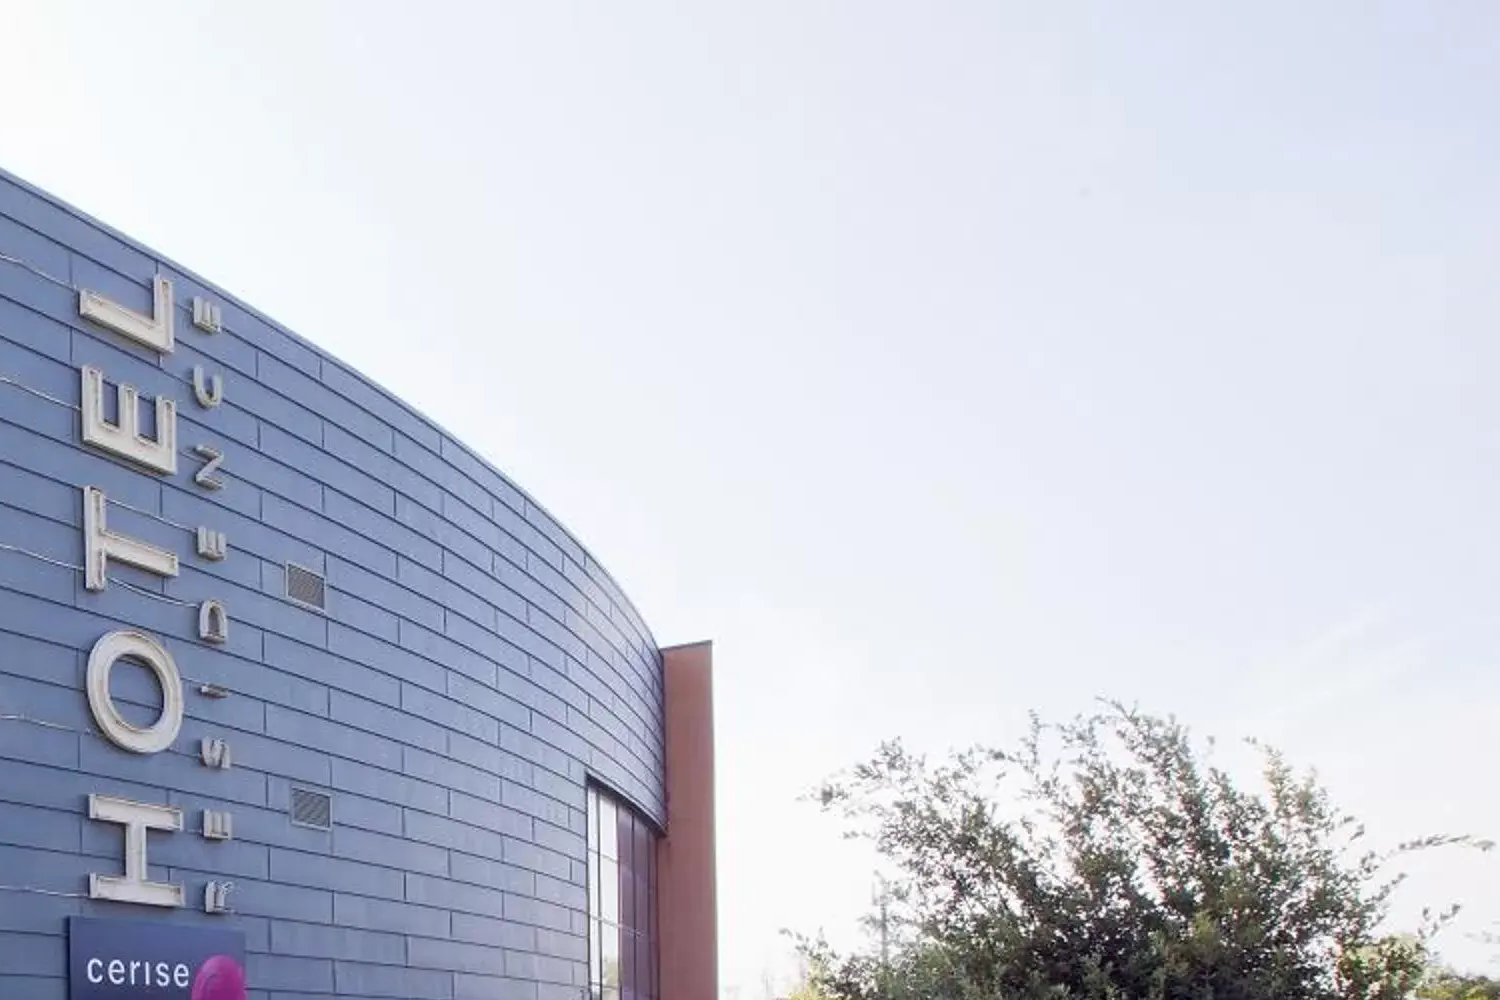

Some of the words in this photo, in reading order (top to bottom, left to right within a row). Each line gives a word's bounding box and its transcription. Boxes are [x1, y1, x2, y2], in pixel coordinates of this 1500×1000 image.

[79, 273, 186, 908] HOTEL
[191, 296, 234, 914] RESIDENCE
[86, 957, 190, 988] cerise
